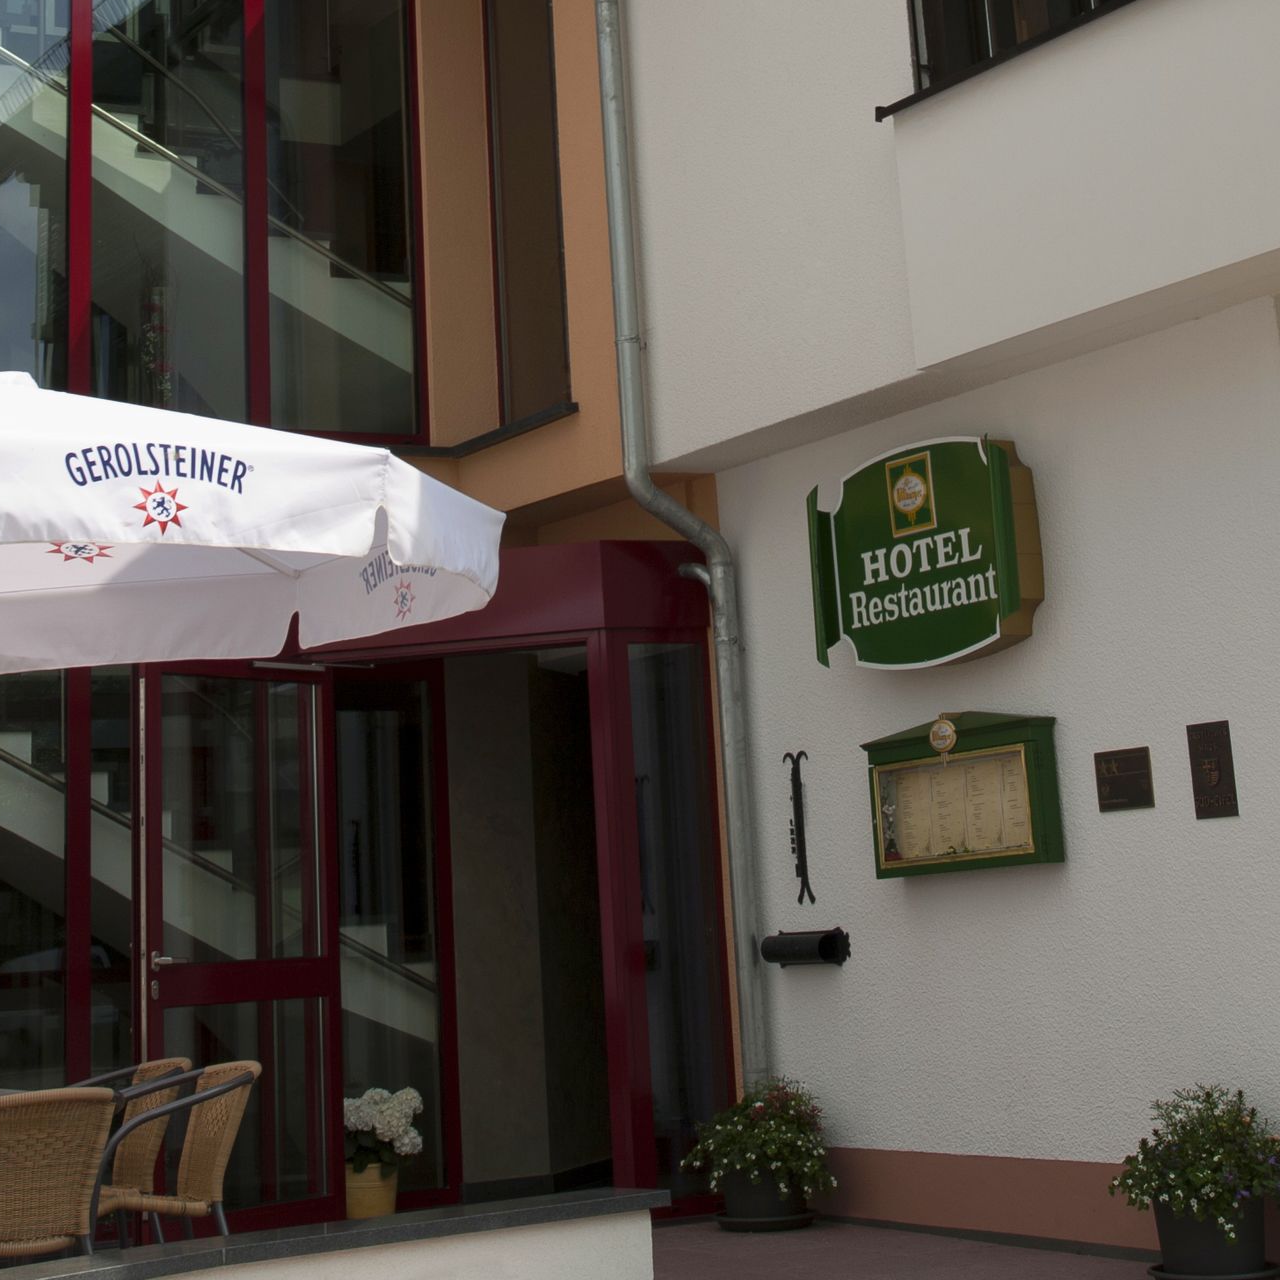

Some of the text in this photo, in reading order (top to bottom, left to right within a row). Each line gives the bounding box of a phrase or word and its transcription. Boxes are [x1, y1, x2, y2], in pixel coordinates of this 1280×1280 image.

[65, 443, 247, 494] GEROLSTEINER
[861, 527, 982, 585] HOTEL
[849, 563, 998, 629] Restaurant
